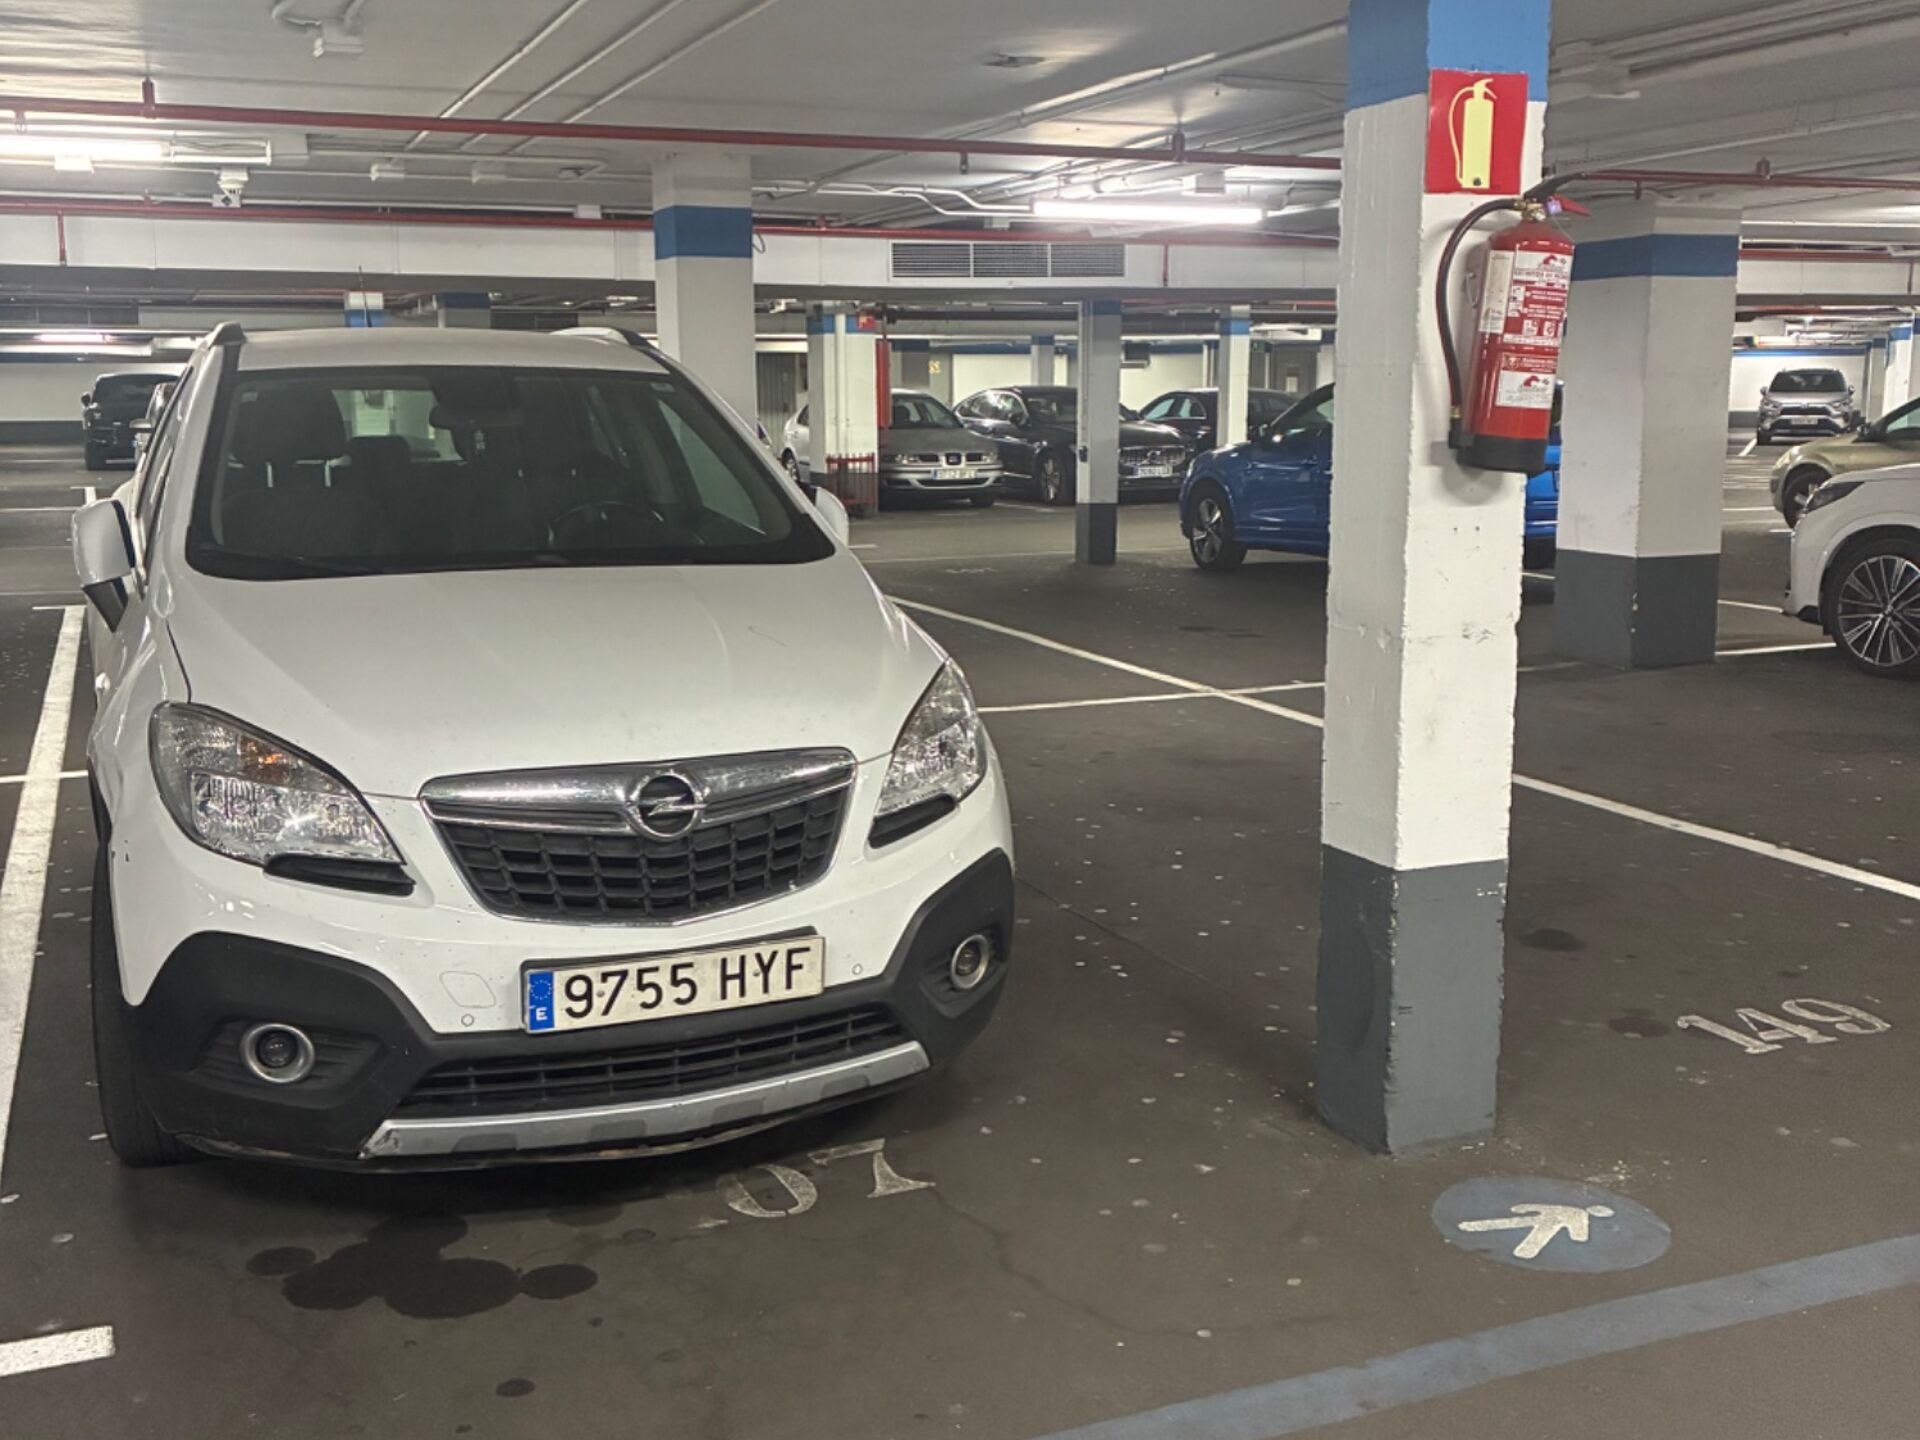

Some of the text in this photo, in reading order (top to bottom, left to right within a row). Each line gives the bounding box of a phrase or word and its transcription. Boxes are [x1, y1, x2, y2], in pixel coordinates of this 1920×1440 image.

[563, 946, 812, 1019] 9755 HYF
[535, 1006, 548, 1022] E
[1676, 997, 1892, 1055] 149
